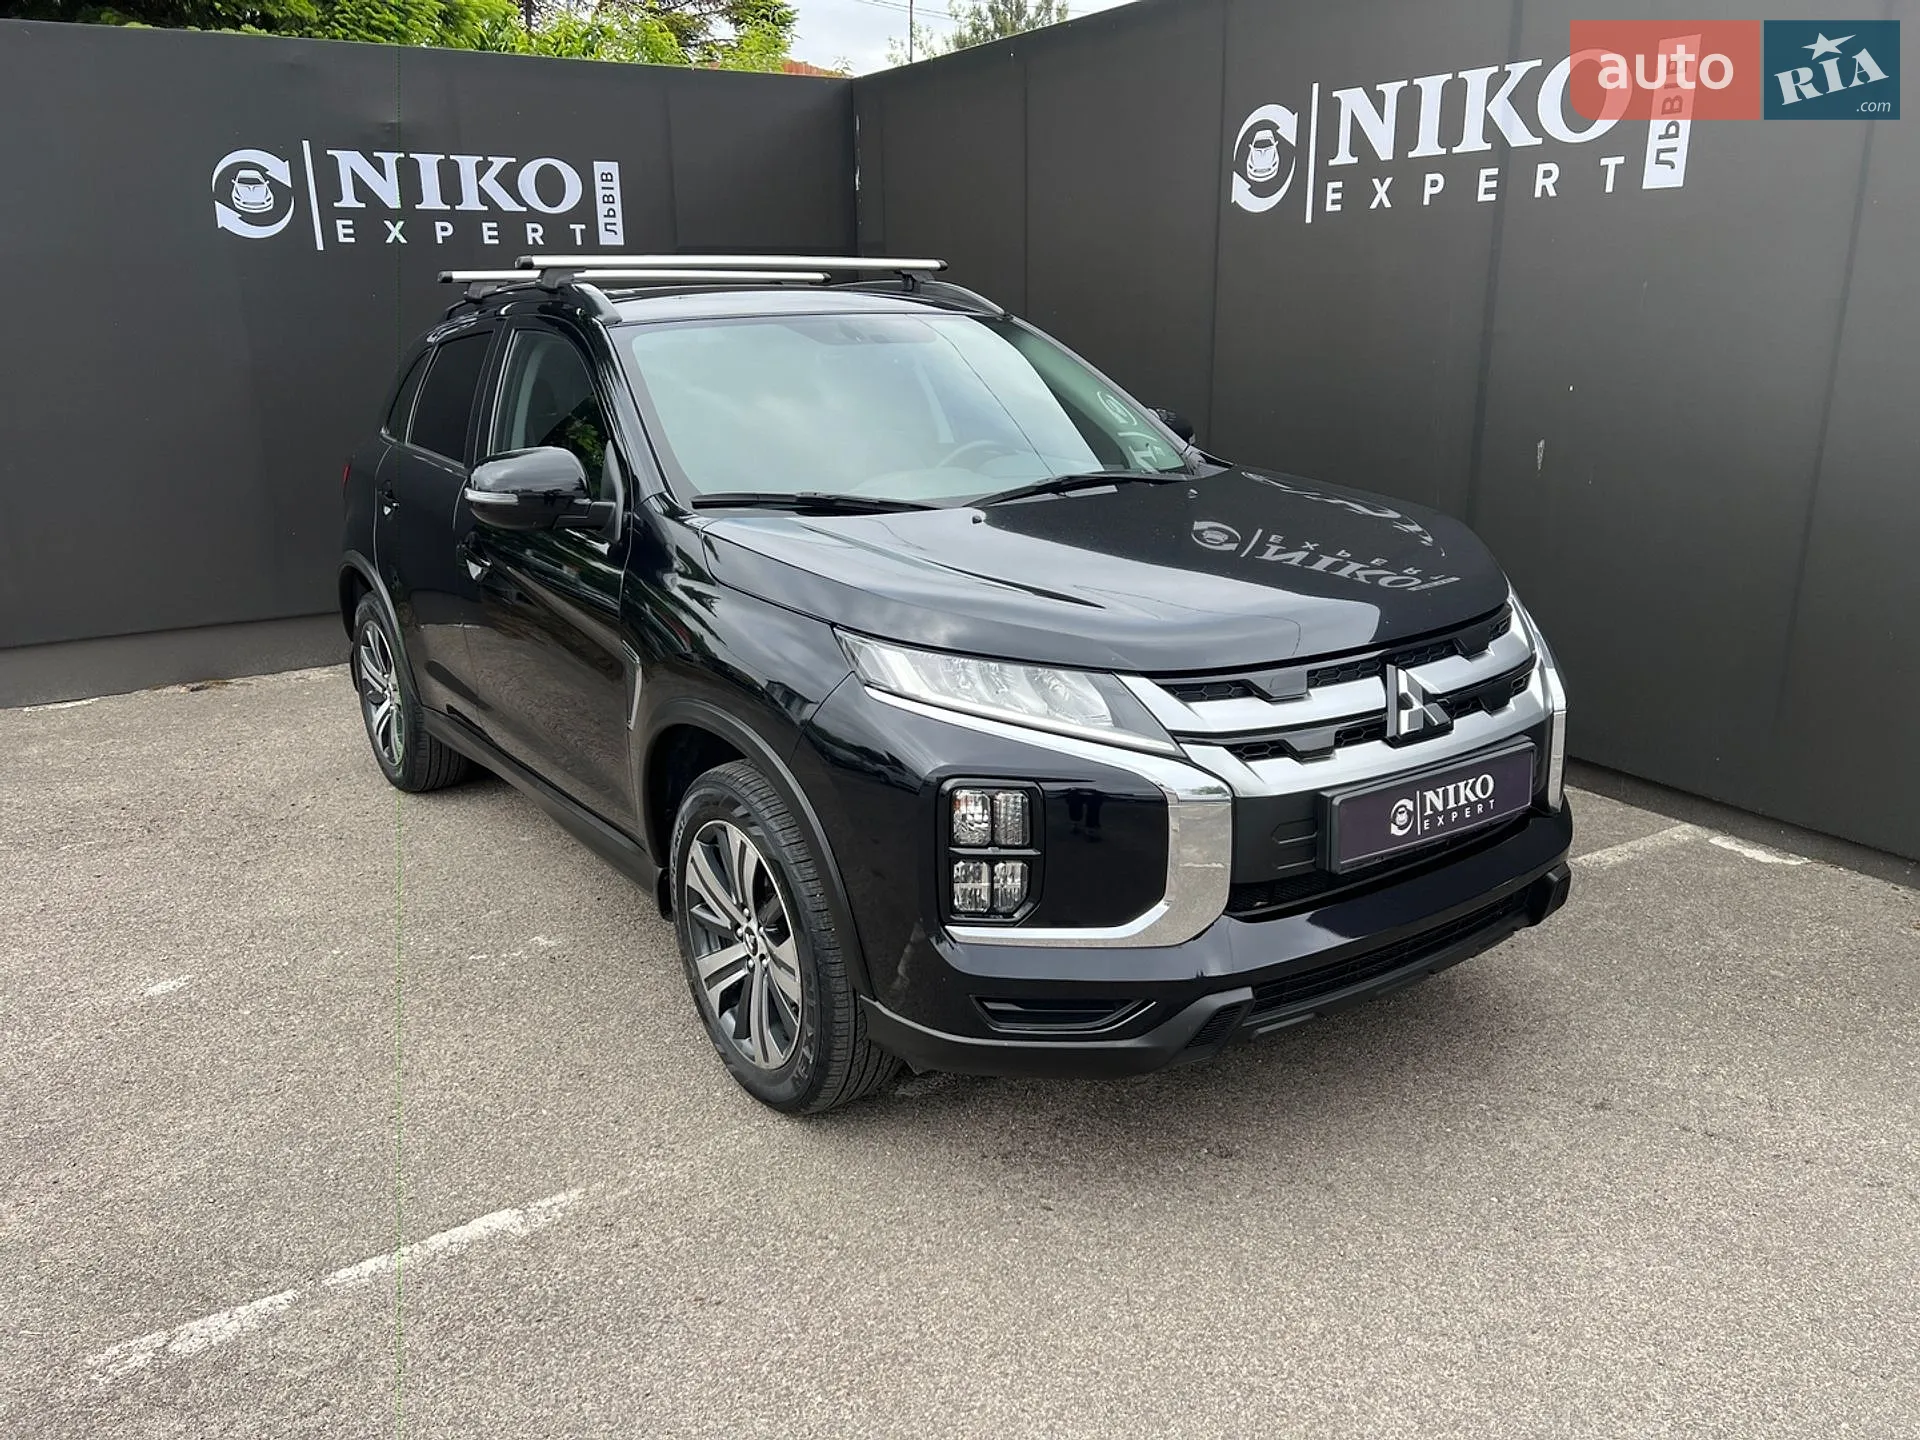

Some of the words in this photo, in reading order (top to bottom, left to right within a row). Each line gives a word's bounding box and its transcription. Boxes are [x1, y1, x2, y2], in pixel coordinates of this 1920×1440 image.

[1328, 48, 1633, 167] NIKO
[326, 149, 583, 214] NIKO
[1325, 155, 1626, 212] EXPERT
[335, 219, 587, 246] EXPERT
[1423, 774, 1495, 816] NIKO
[1423, 799, 1496, 831] EXPERT
